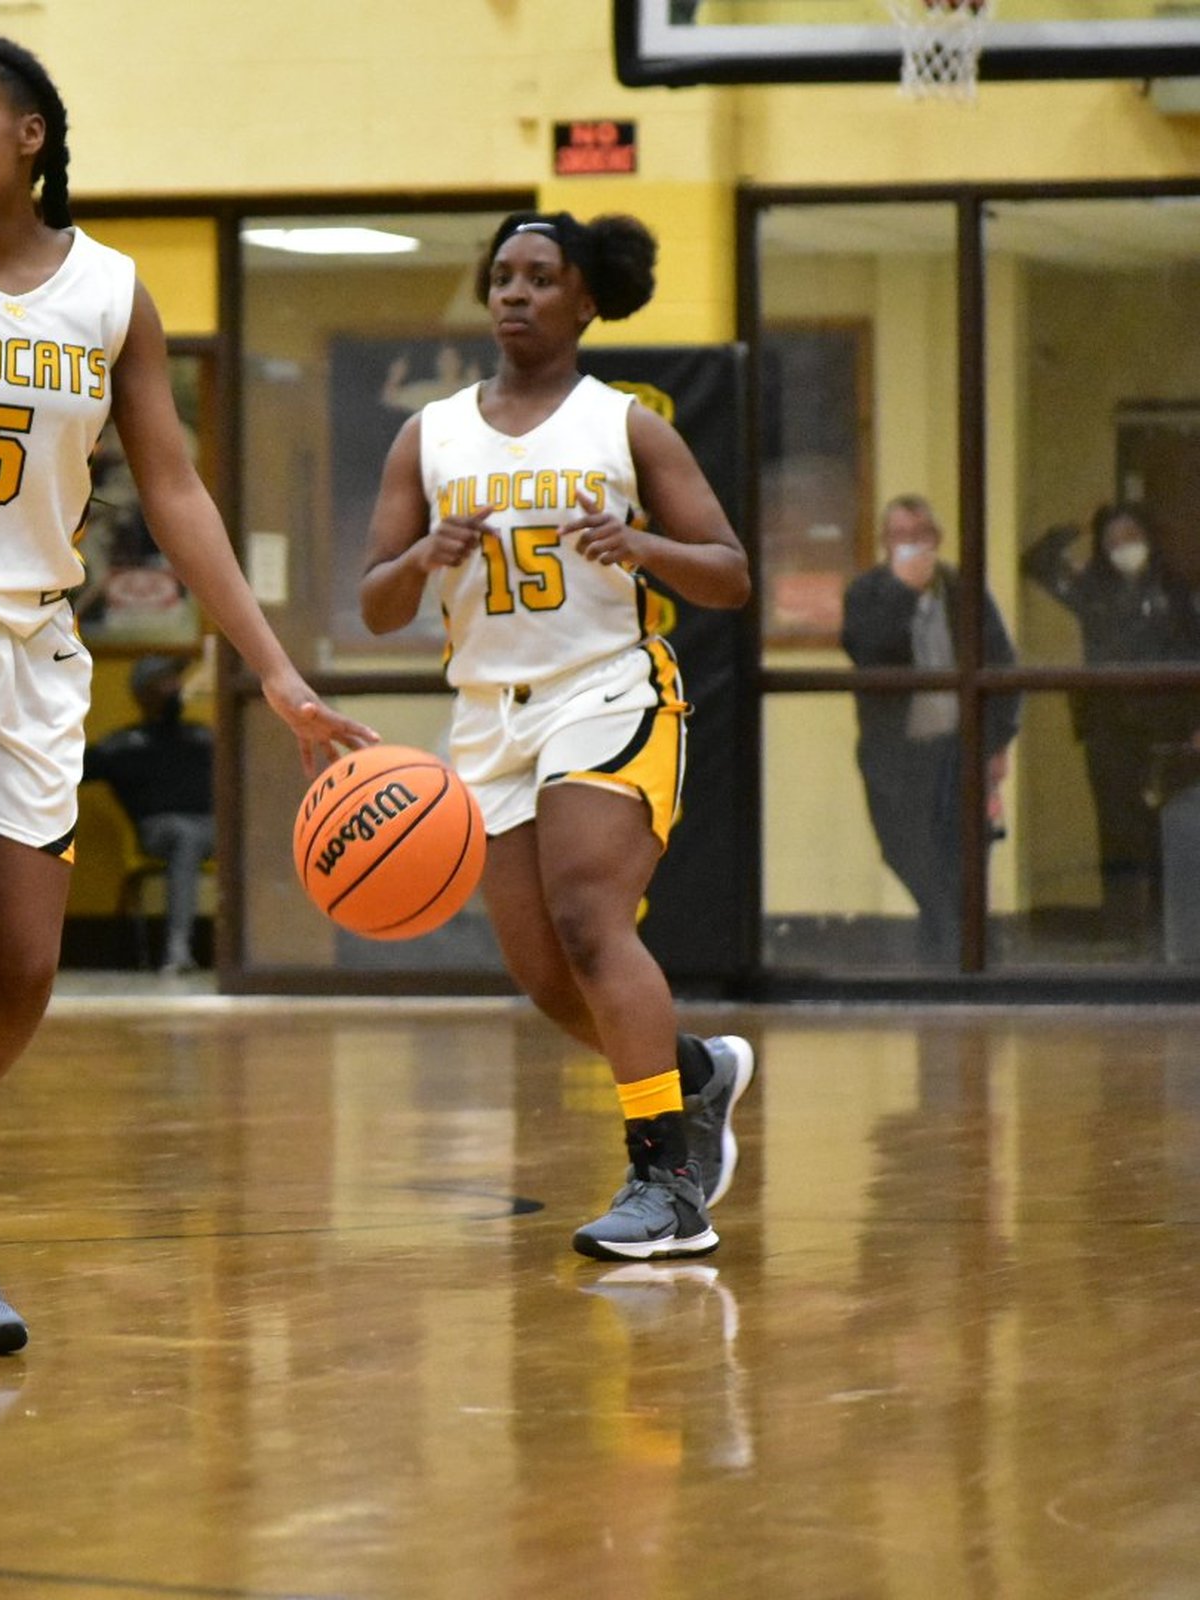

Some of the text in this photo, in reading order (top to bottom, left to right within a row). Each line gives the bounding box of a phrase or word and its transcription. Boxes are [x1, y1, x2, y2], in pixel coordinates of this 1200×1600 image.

[436, 469, 607, 519] WILDCATS
[479, 524, 566, 615] 15
[314, 781, 419, 877] Wilson
